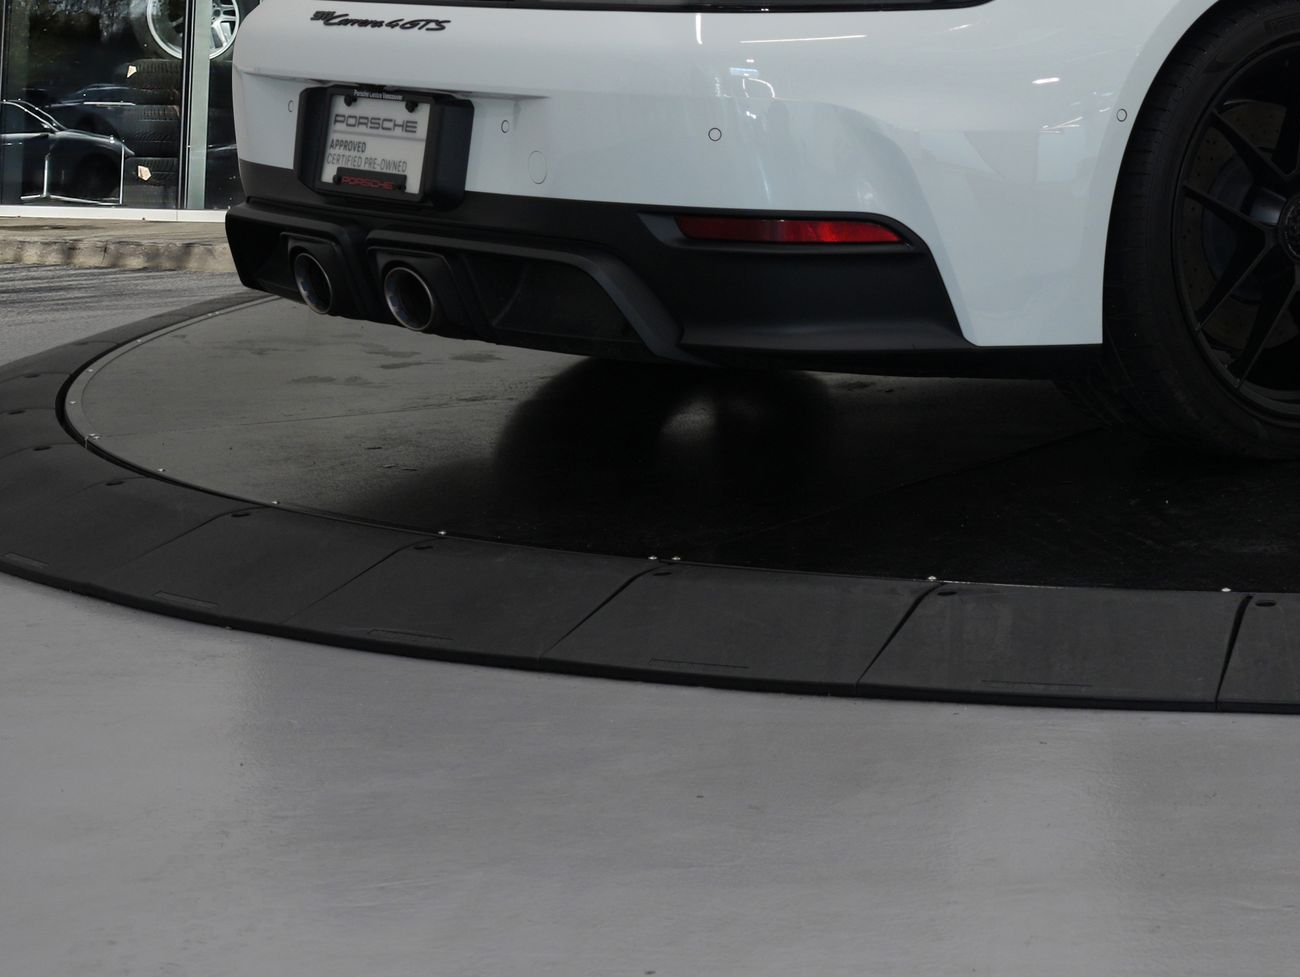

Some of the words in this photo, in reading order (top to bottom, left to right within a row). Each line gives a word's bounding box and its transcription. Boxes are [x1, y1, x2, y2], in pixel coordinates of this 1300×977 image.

[323, 13, 385, 28] Carrera
[399, 19, 451, 31] GTS
[333, 113, 418, 134] PORSCHE
[329, 138, 367, 153] APPROVED
[326, 152, 363, 167] CERTIFIED
[364, 156, 408, 173] PRE-OWNED
[341, 175, 394, 190] PORSCHE
